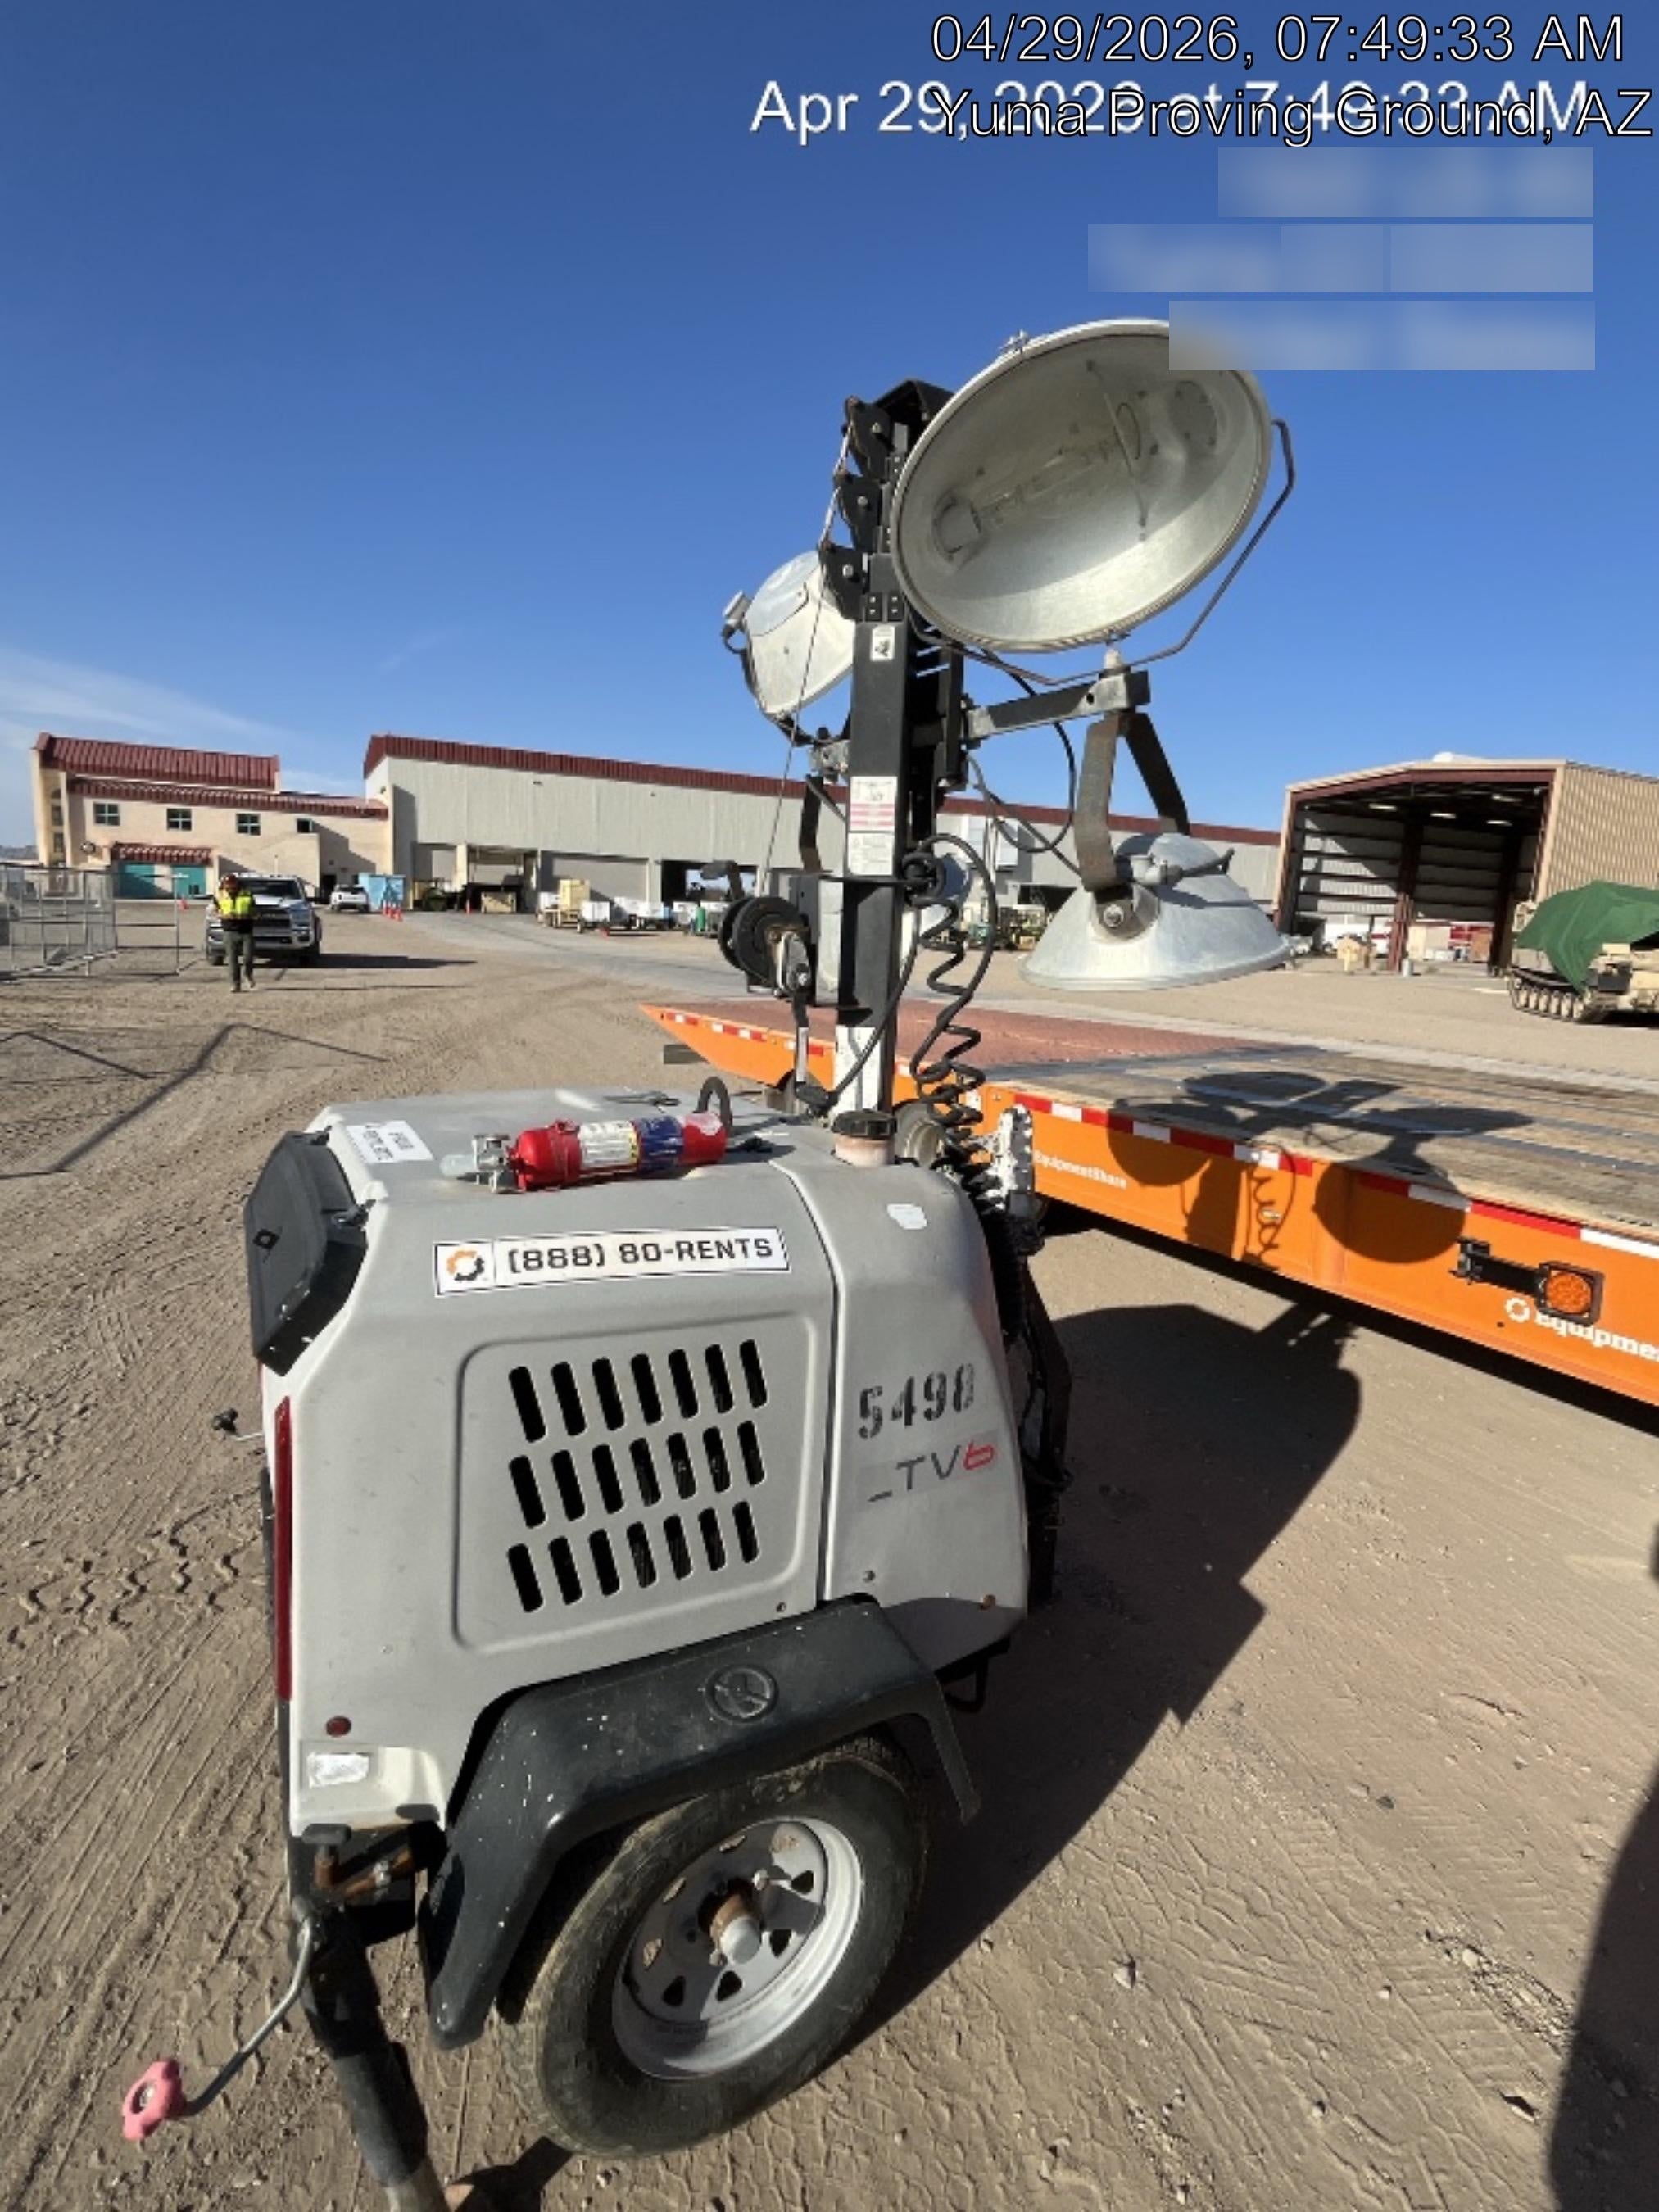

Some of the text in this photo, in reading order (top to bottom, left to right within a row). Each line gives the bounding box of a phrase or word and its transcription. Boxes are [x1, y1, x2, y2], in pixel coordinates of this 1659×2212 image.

[507, 1236, 773, 1274] (888) 80-RENTS
[1534, 1311, 1659, 1362] Equipme
[858, 1362, 975, 1439] 5498
